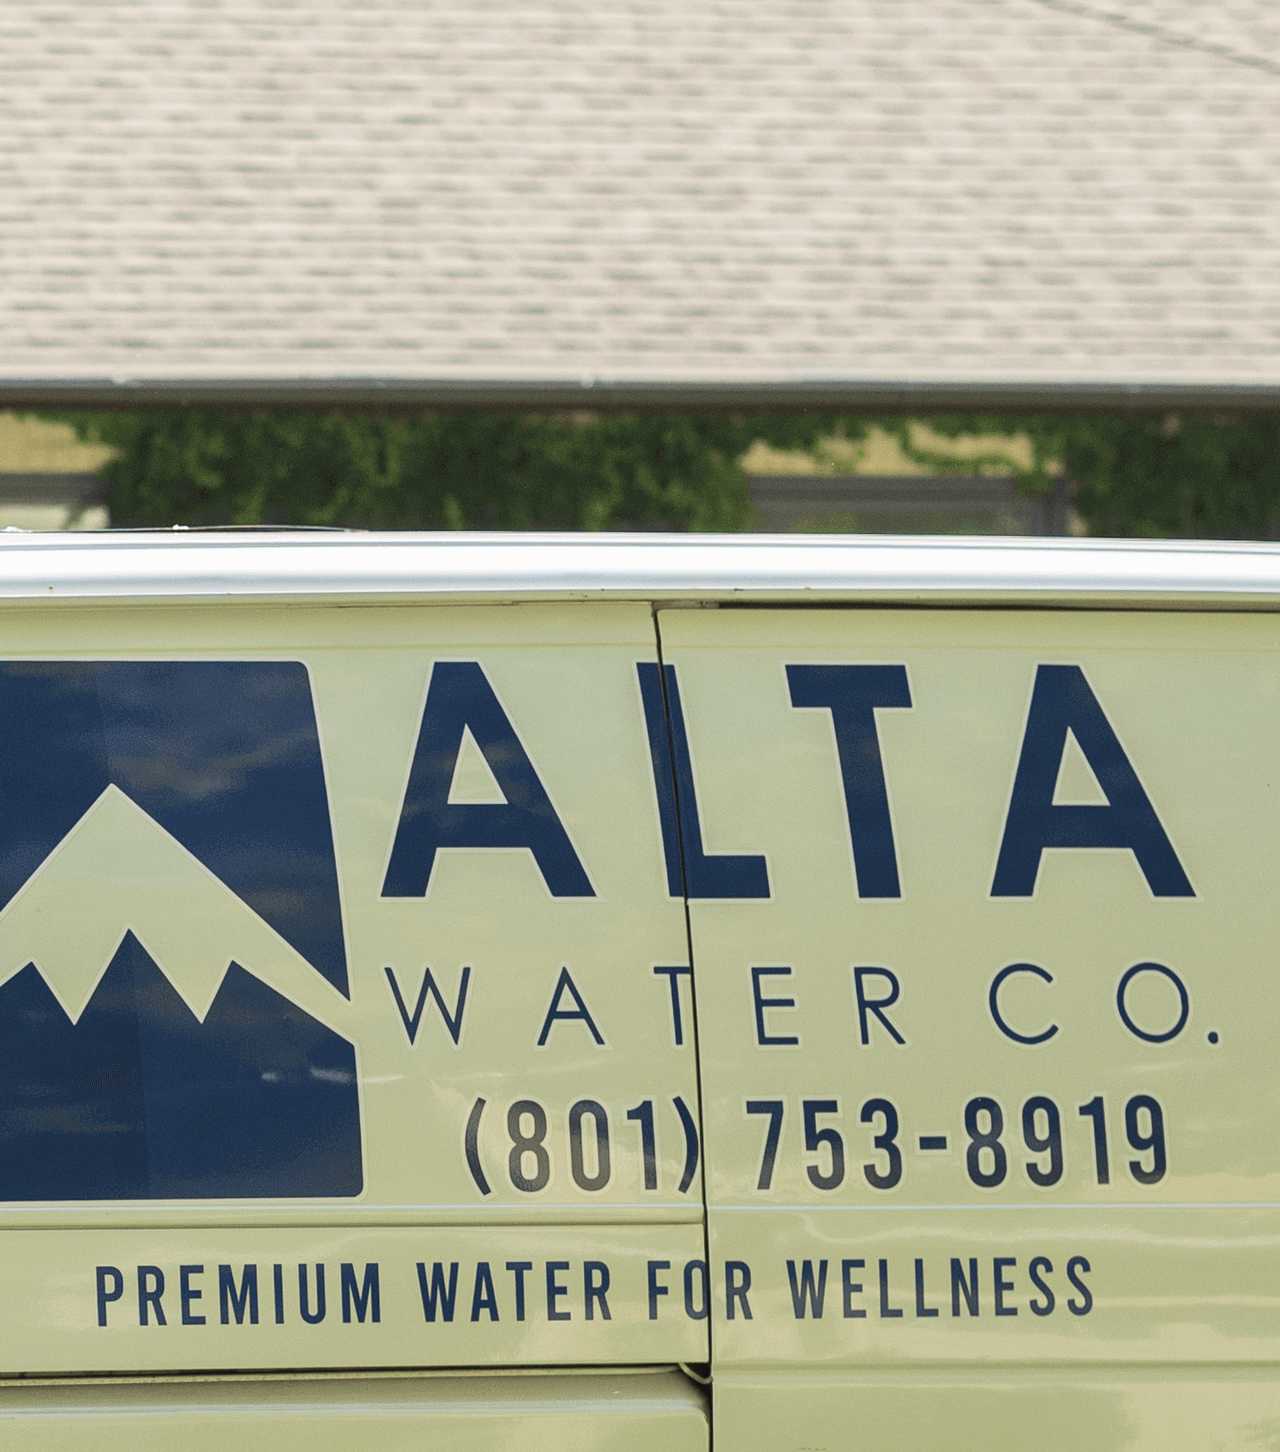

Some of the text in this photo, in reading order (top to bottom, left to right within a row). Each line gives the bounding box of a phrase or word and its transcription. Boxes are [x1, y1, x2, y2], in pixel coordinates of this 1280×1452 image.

[380, 661, 1197, 899] ALTA
[384, 961, 1220, 1047] WATER CO.
[463, 1093, 1169, 1196] (801) 753-8919
[96, 1256, 1095, 1327] PREMIUM WATER FOR WELLNESS
